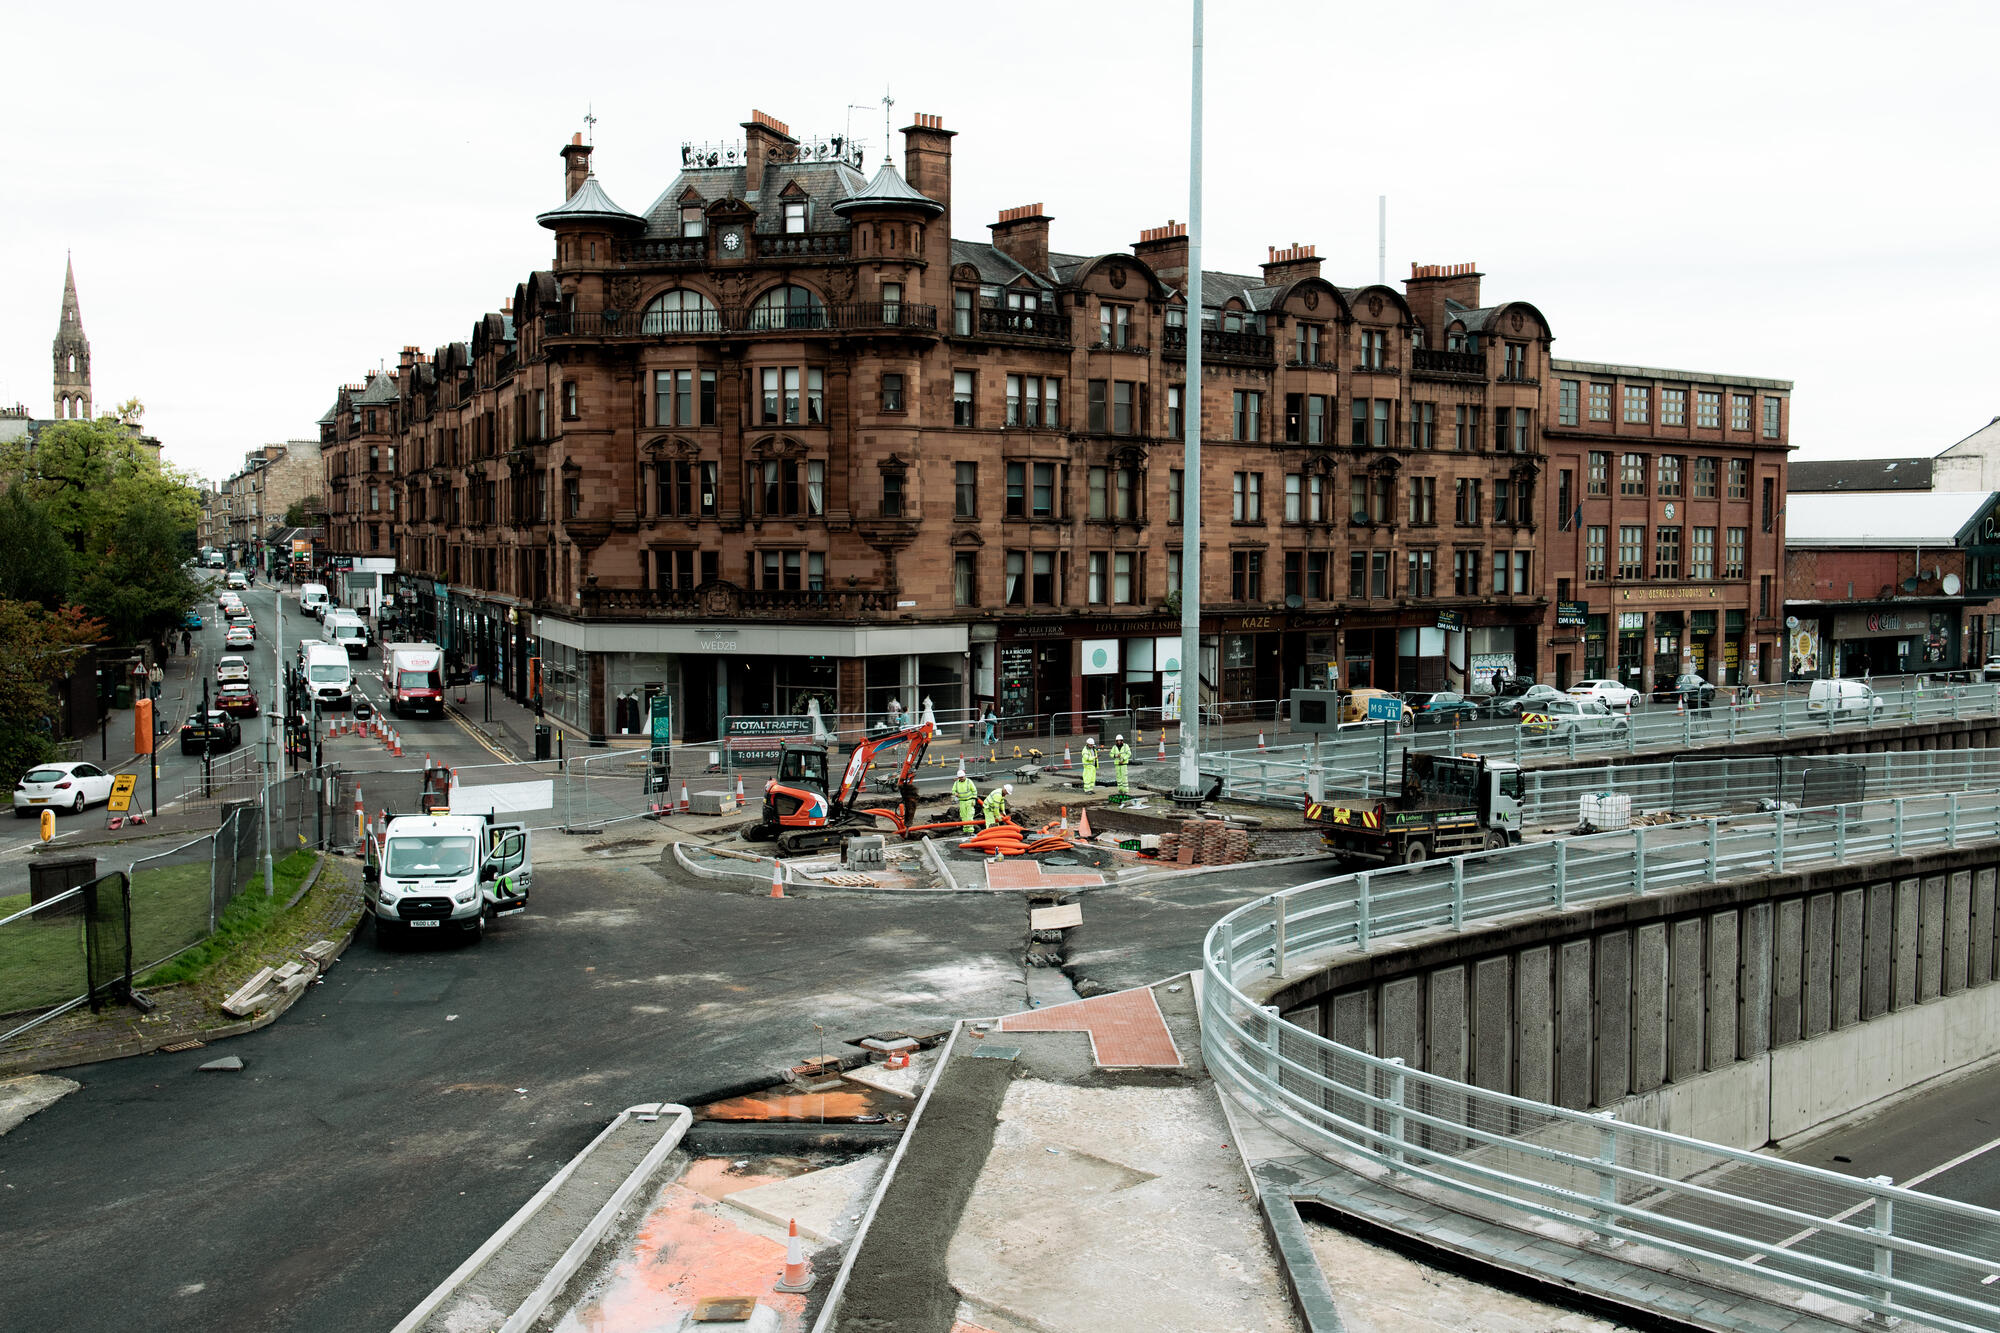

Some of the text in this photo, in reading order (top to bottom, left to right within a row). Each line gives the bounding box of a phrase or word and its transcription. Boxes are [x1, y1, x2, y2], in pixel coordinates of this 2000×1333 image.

[1678, 588, 1702, 598] STUDIOS
[1096, 620, 1182, 632] LOVE THOSE LASHES
[1241, 617, 1271, 628] KAZE
[1446, 624, 1459, 632] HALL
[700, 641, 737, 651] WED2B
